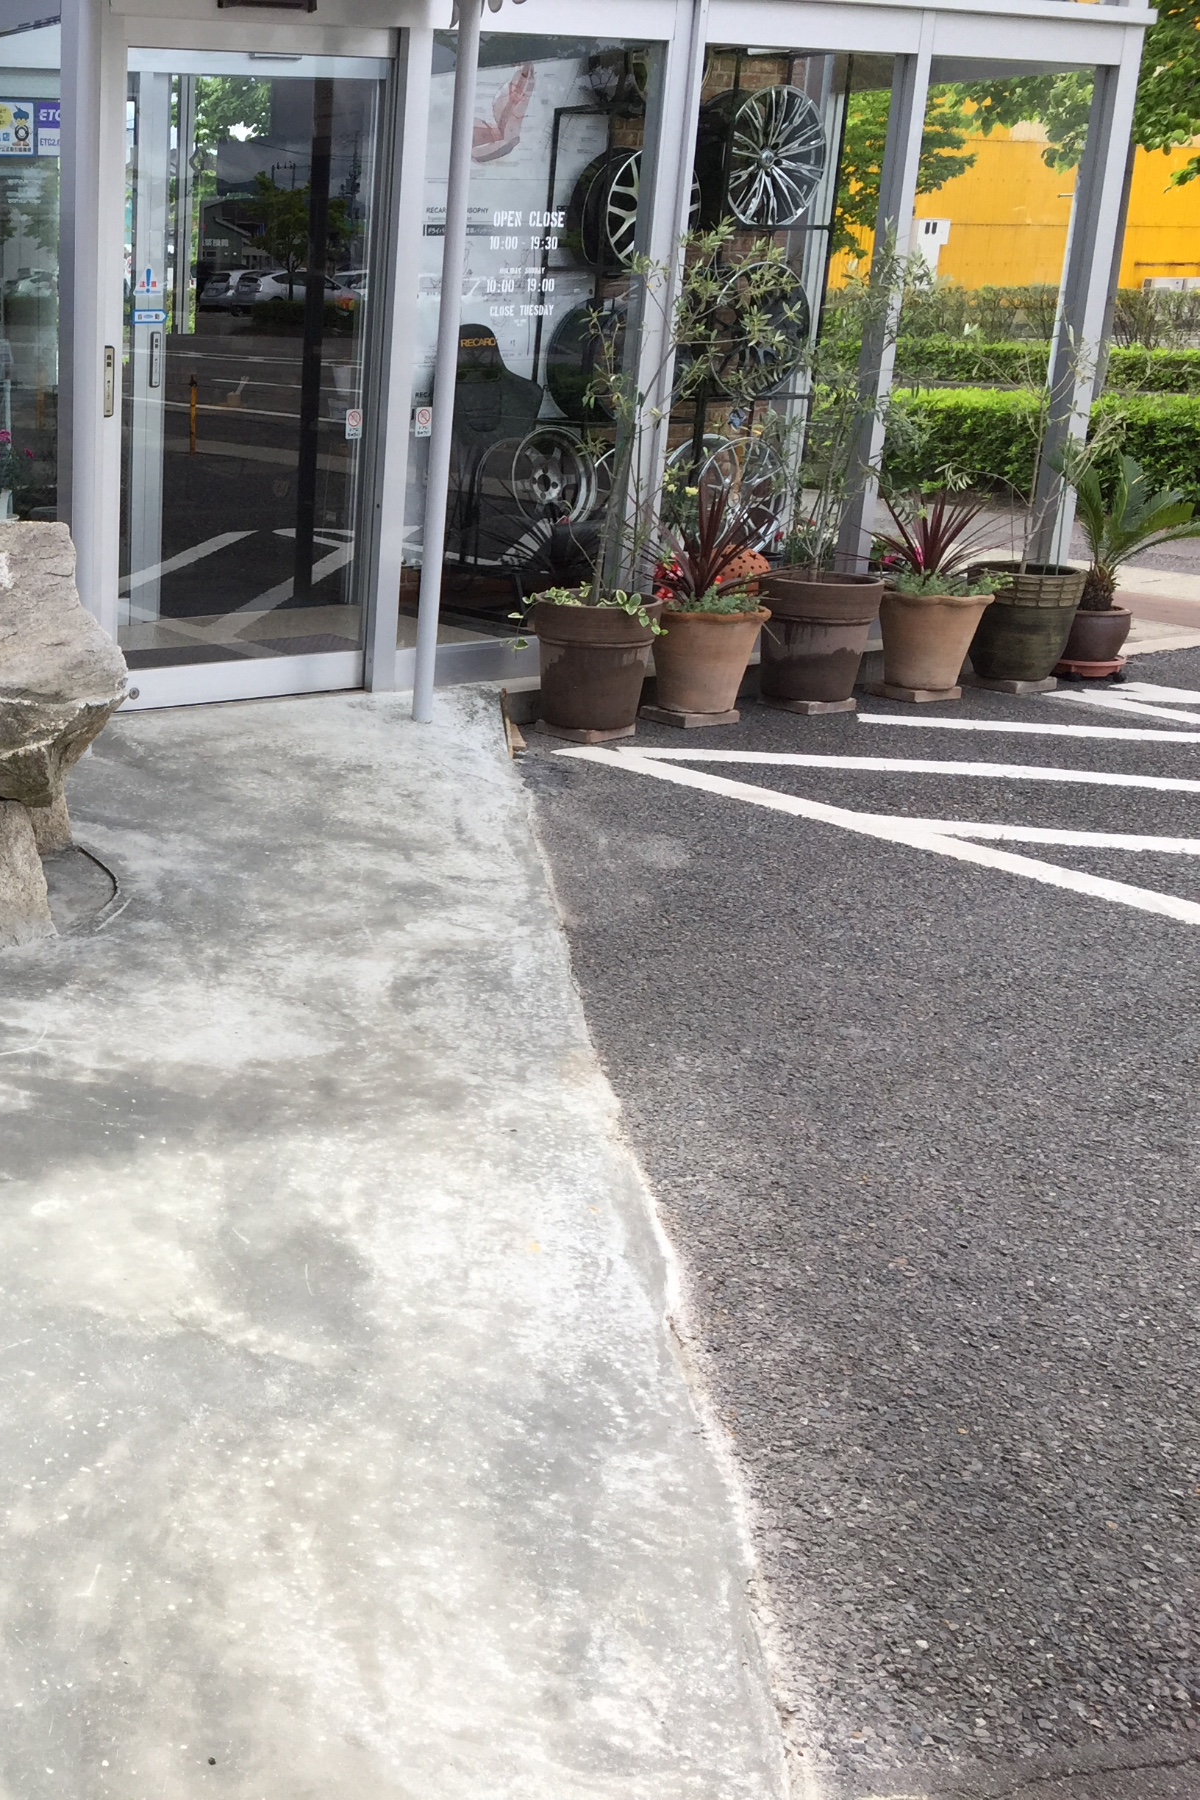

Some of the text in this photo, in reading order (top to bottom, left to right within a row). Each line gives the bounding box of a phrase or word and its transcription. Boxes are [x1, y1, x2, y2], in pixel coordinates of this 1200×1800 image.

[425, 206, 447, 214] RECAR
[493, 210, 566, 228] OPEN CLOSE
[489, 235, 518, 250] 10:00
[530, 235, 558, 250] 19:30
[486, 278, 555, 293] 10:00 19:00
[489, 304, 554, 316] CLOSE TUESDAY
[460, 337, 497, 347] RECARO
